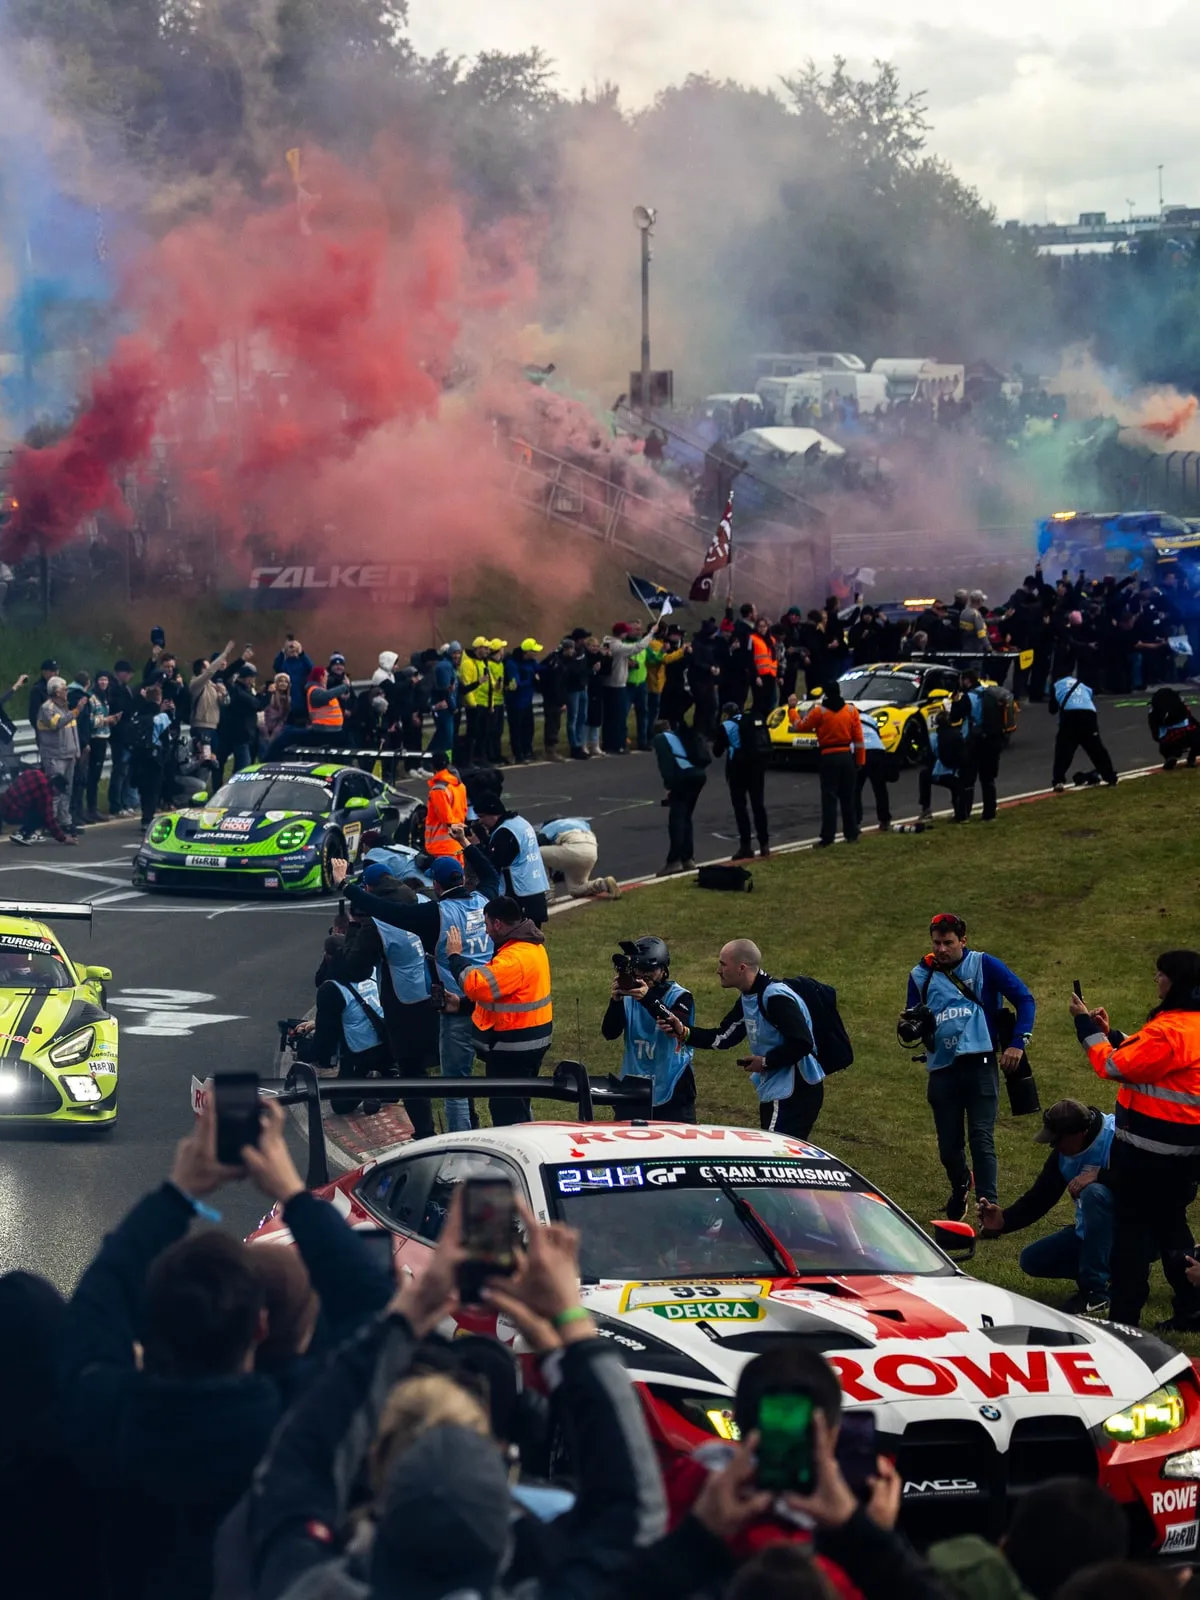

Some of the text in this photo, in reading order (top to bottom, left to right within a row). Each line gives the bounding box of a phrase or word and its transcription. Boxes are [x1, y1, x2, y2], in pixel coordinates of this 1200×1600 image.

[1, 936, 52, 951] TURISMO
[465, 934, 490, 955] TV
[935, 1007, 973, 1026] MEDIA
[633, 1039, 657, 1060] TV
[565, 1128, 772, 1146] ROWE
[557, 1164, 644, 1193] 24H
[699, 1166, 846, 1183] GRAN TURISMO
[797, 1179, 852, 1188] SIMULATOR
[669, 1286, 722, 1298] 99
[664, 1302, 752, 1319] DEKRA
[828, 1350, 1114, 1402] ROWE
[1151, 1485, 1198, 1514] ROWE
